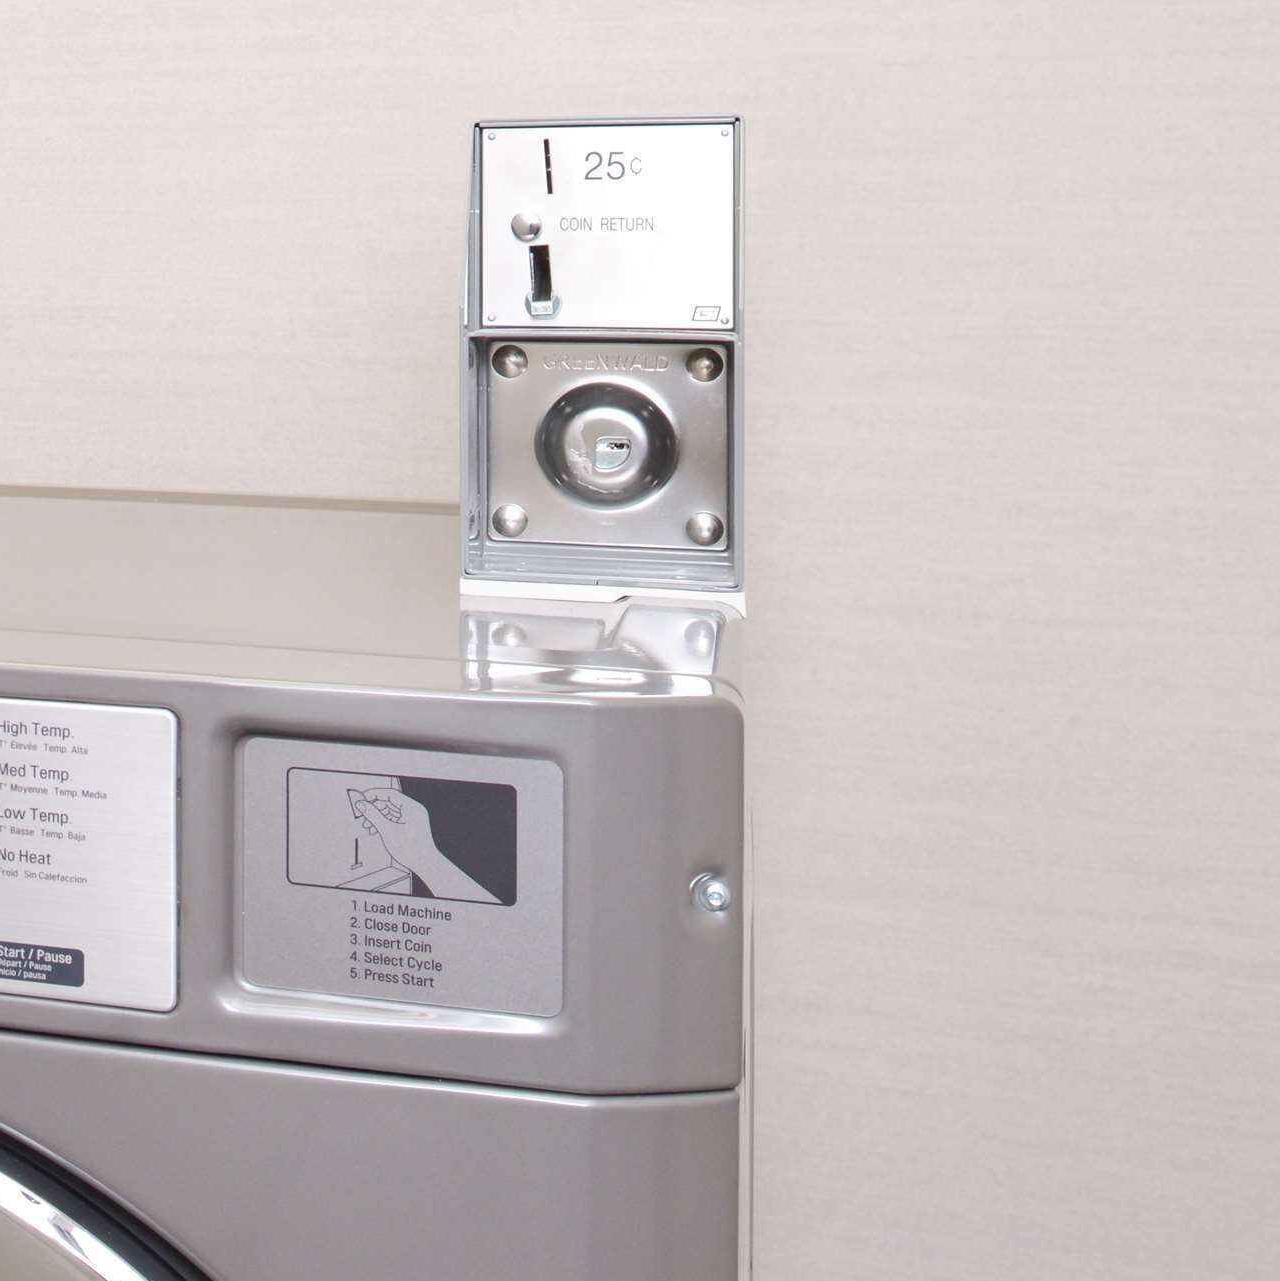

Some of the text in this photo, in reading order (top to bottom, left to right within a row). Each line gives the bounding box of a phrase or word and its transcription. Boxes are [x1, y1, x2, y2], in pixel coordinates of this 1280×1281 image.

[560, 217, 654, 232] COIN RETURN
[31, 722, 74, 741] Temp.
[29, 765, 73, 784] Temp.
[29, 807, 72, 827] Temp.
[19, 850, 52, 866] Heat
[352, 900, 452, 921] 1. Load Machine
[350, 916, 432, 936] 2. Close Door
[350, 934, 432, 954] 3. Insert Coin
[29, 961, 53, 971] Pause
[37, 949, 73, 965] Pause
[349, 951, 443, 974] 4. Select Cycle
[349, 968, 435, 988] 5. Press Start
